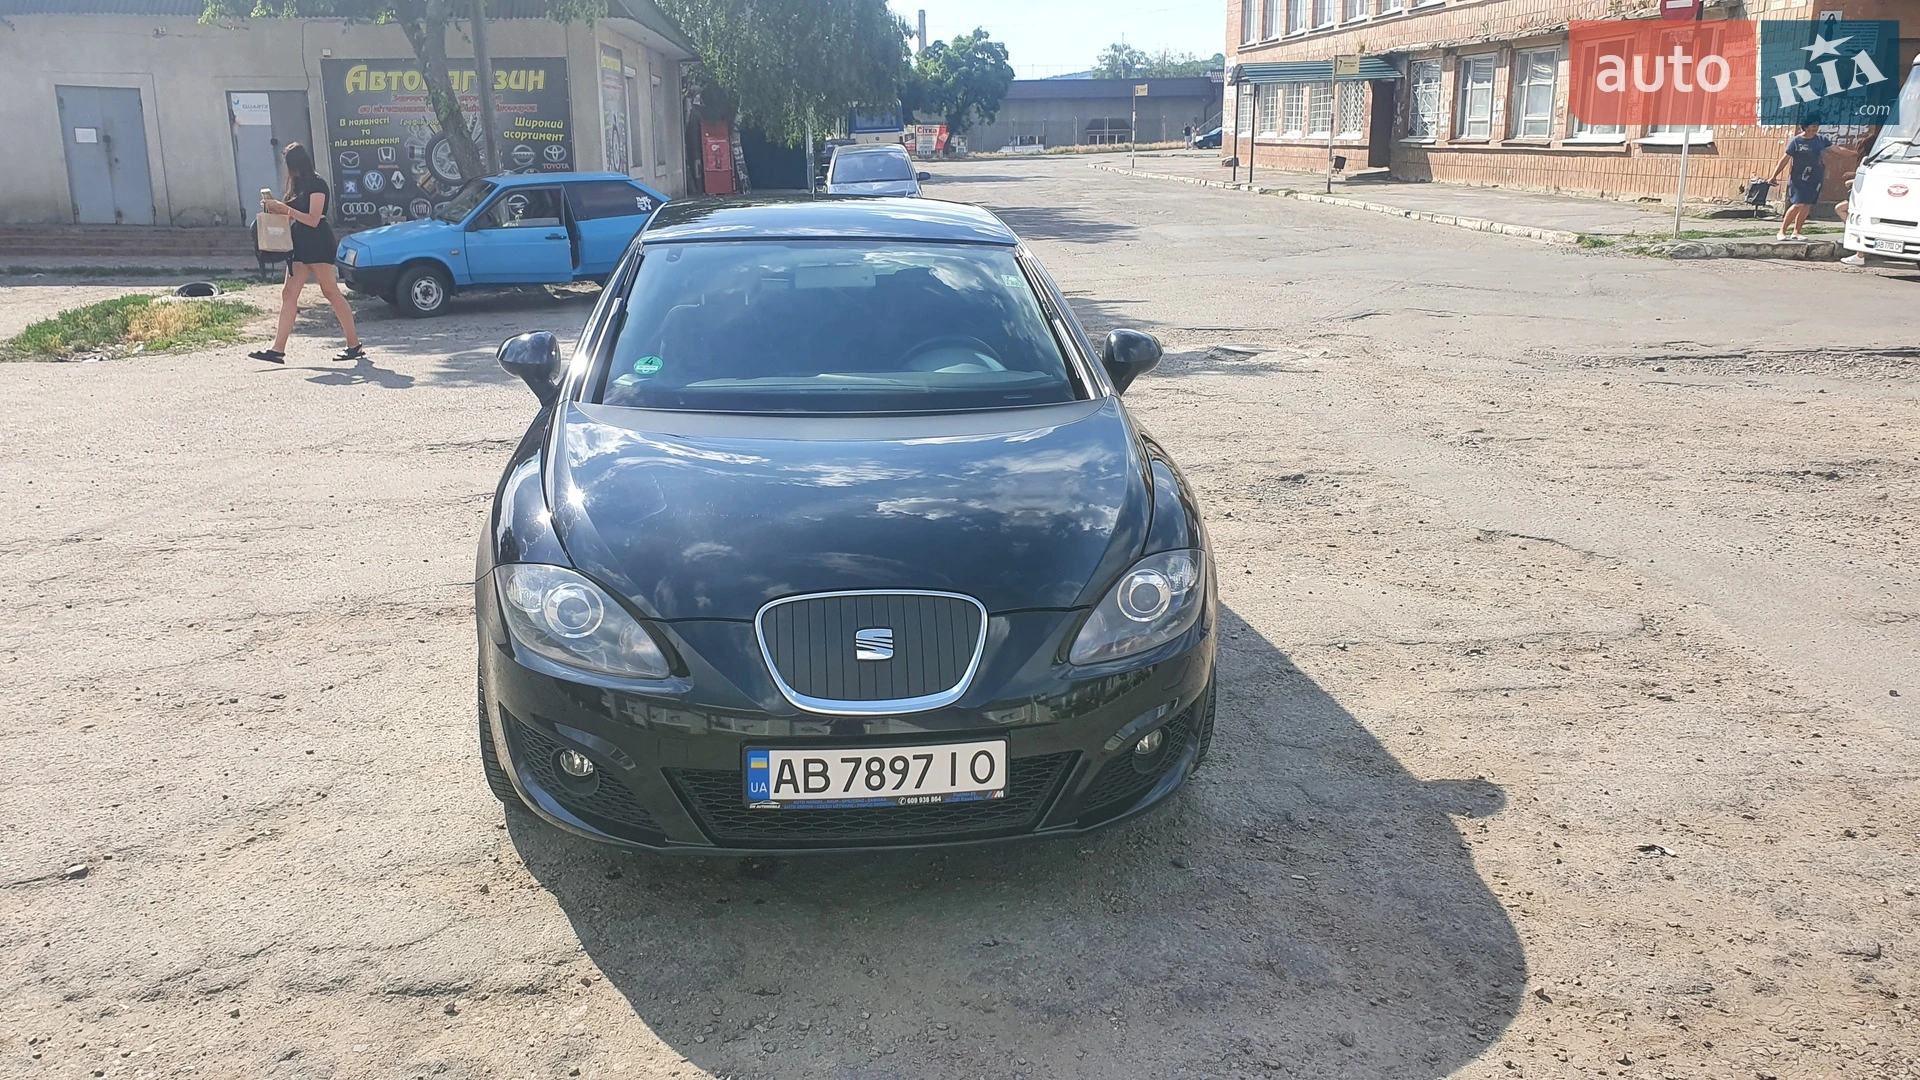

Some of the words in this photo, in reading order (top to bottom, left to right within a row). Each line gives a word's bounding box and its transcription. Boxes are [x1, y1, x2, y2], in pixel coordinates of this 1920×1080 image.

[345, 65, 545, 93] Автоагзин
[514, 117, 564, 129] Широкий
[350, 137, 400, 146] замовлення
[503, 131, 565, 141] асортимент
[773, 758, 831, 794] AB
[840, 753, 934, 793] 7897
[750, 782, 767, 793] UA
